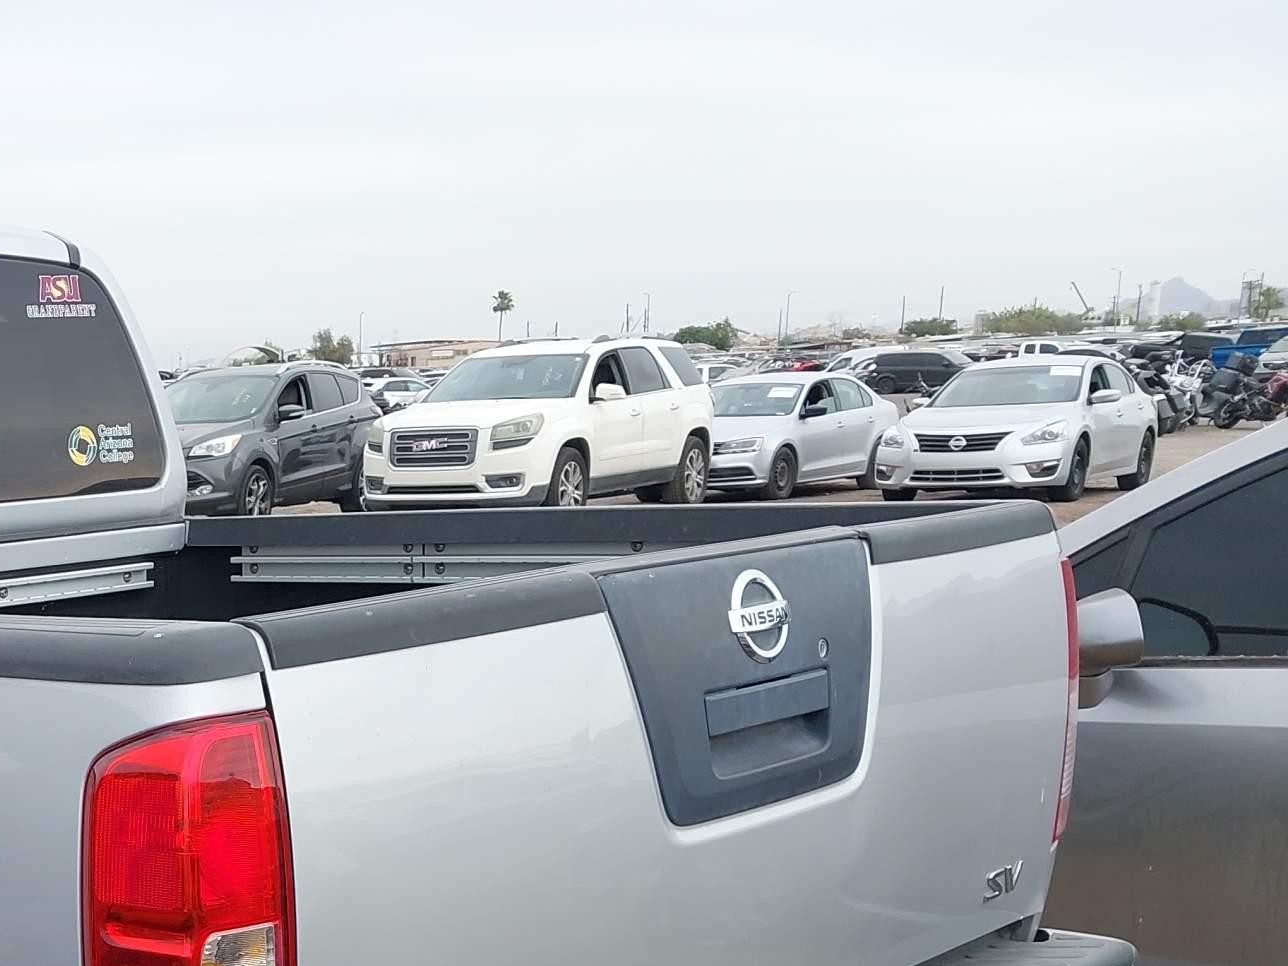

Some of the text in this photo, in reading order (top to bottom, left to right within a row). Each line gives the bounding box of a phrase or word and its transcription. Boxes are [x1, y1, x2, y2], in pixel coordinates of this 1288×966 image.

[38, 274, 82, 302] ASU
[26, 303, 96, 318] GRANDPARENT
[97, 423, 132, 438] Central
[99, 437, 134, 450] Arizona
[412, 437, 448, 452] GMC
[99, 449, 135, 464] College
[740, 606, 788, 628] NISSAN
[983, 860, 1024, 904] SV
